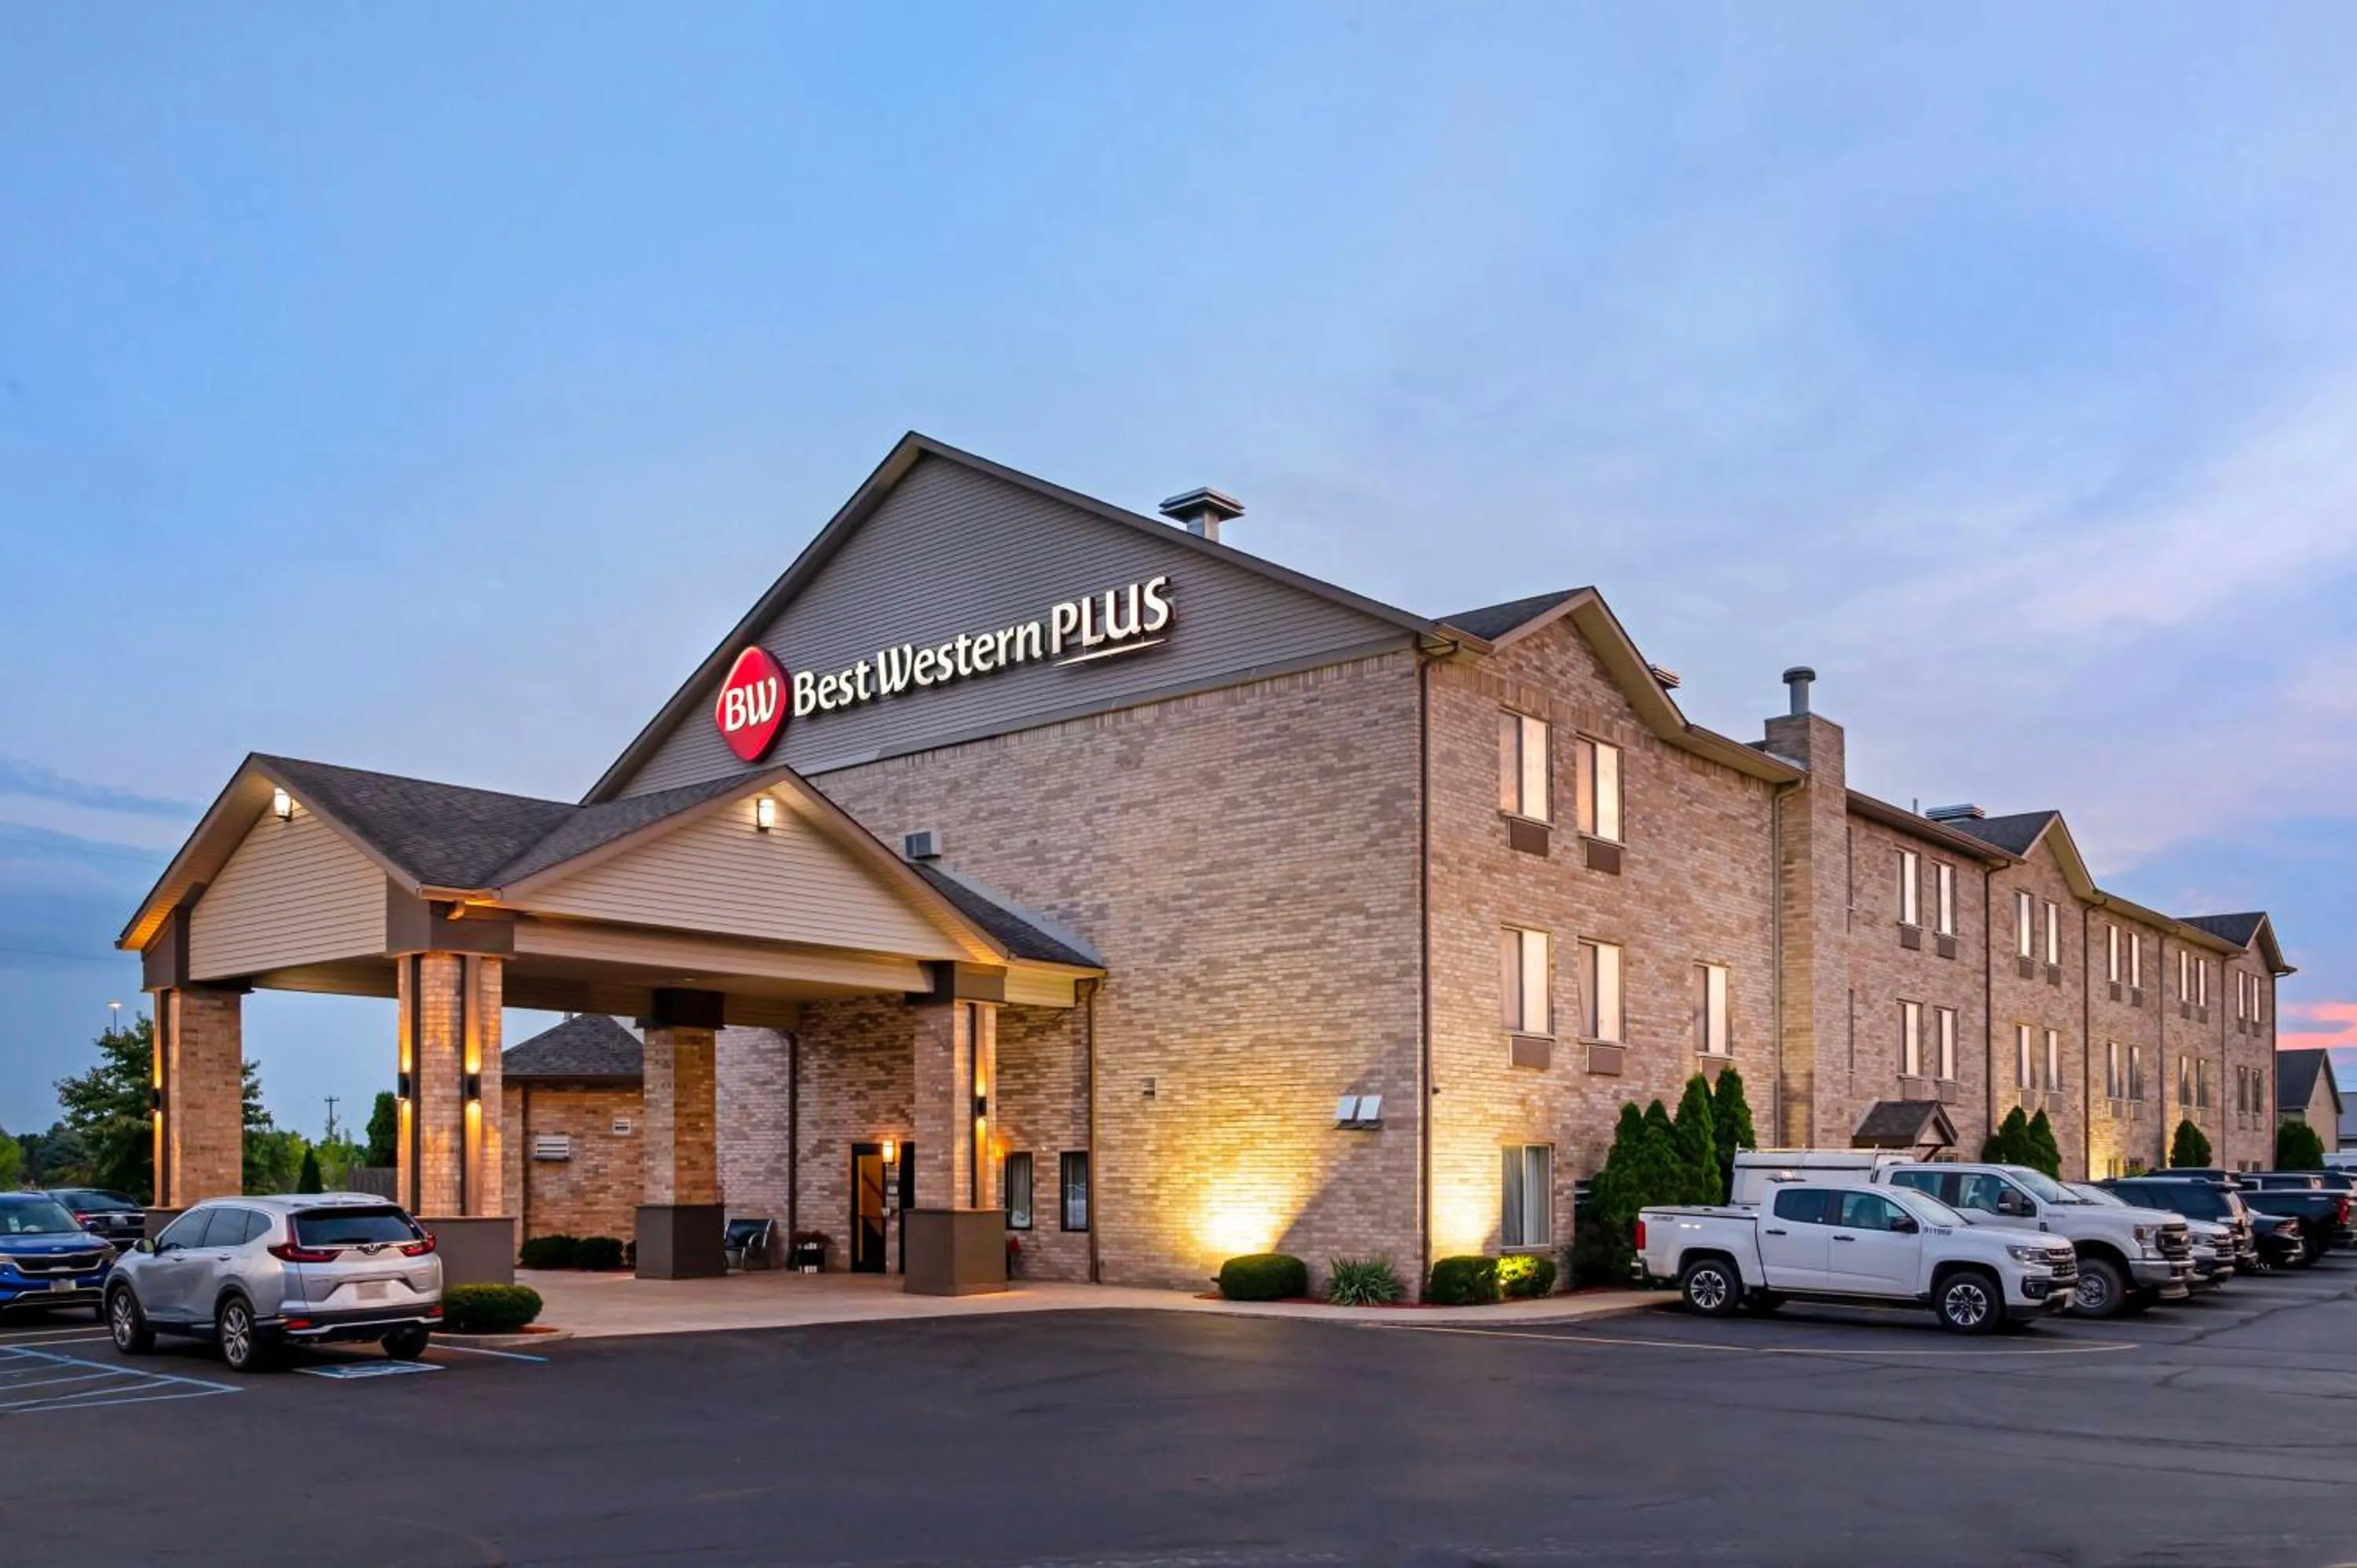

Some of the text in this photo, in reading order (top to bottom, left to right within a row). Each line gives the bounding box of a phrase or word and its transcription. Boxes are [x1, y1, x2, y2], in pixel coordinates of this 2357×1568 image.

[794, 576, 1168, 716] Best Western PLUS
[725, 676, 778, 731] BW
